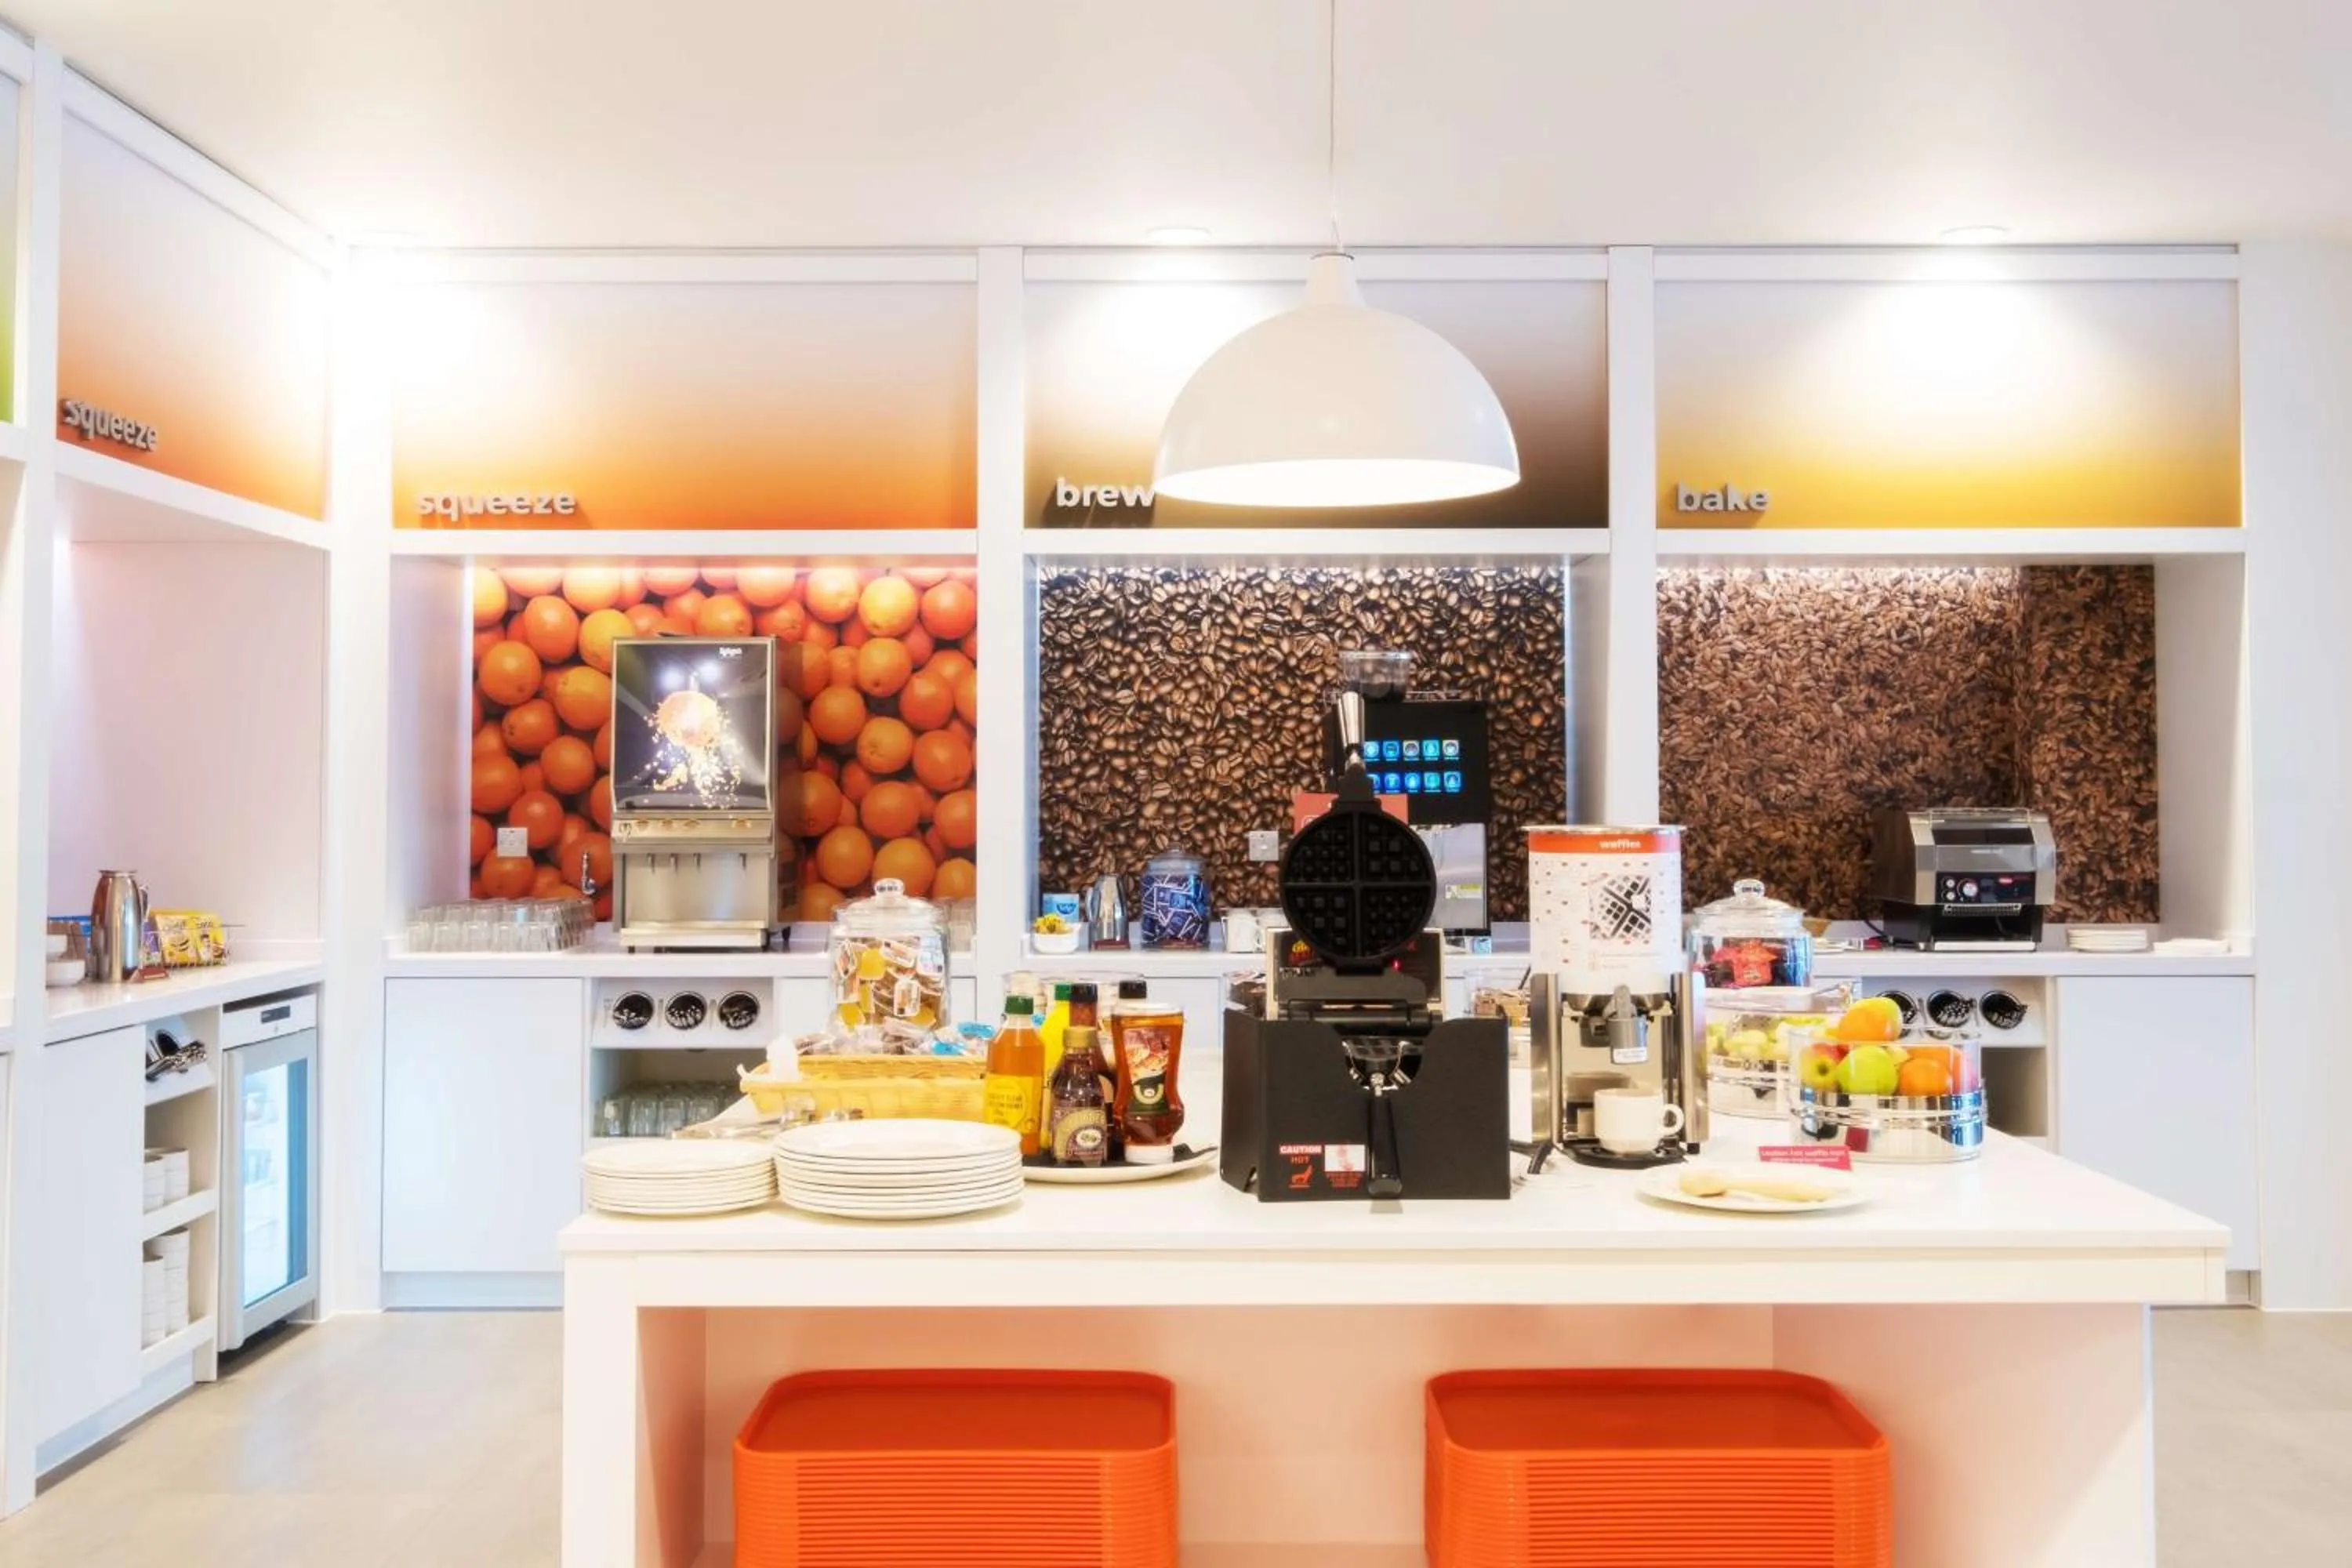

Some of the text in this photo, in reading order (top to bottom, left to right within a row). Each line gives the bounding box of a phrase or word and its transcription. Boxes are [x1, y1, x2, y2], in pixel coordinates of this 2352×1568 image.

[64, 400, 158, 452] squeeze
[419, 491, 576, 522] squeeze
[1055, 477, 1156, 507] brew
[1676, 478, 1769, 512] bake
[1600, 838, 1641, 851] waffles
[1279, 1145, 1322, 1154] CAUTION
